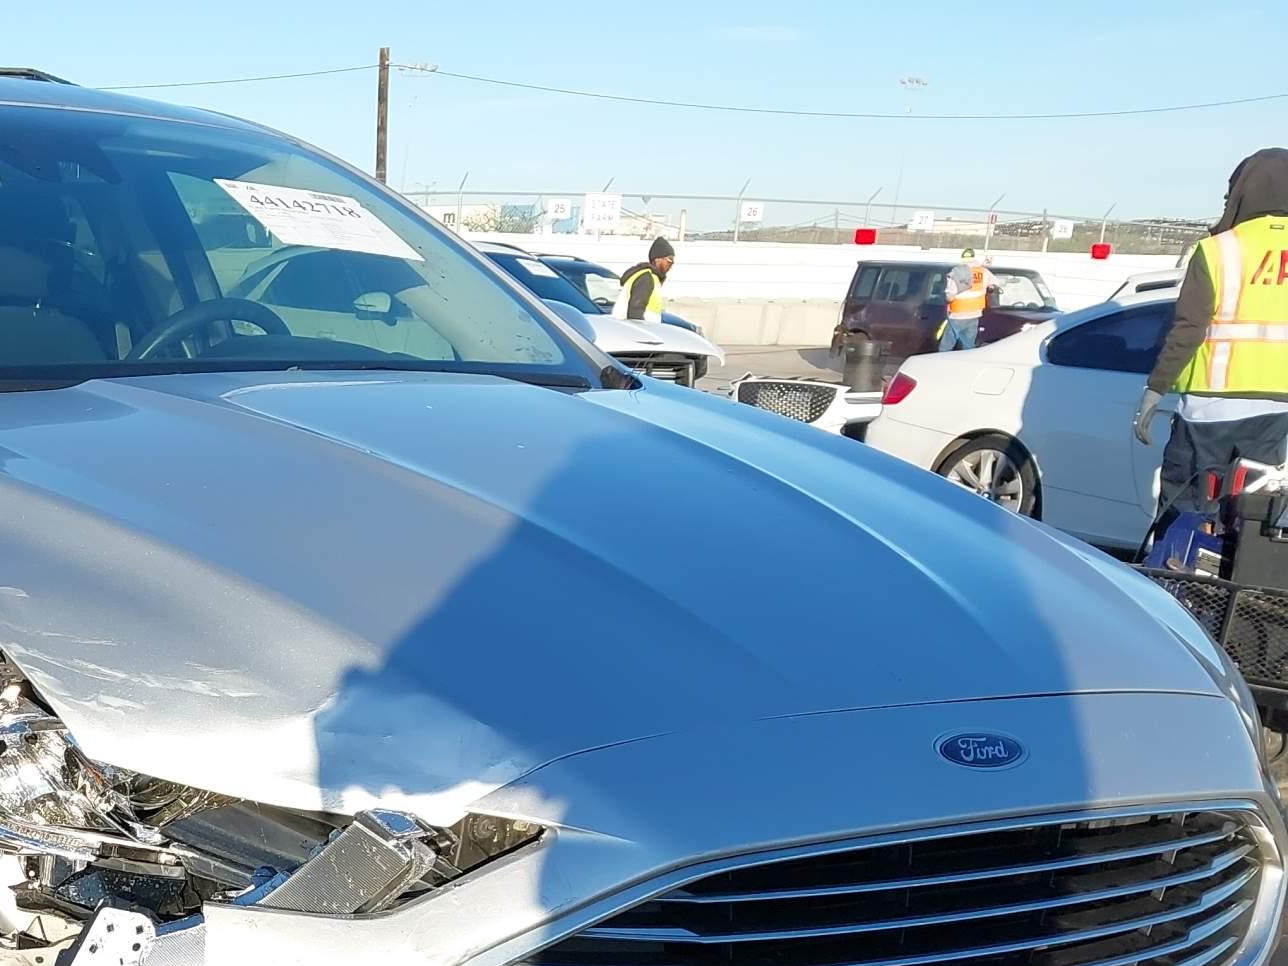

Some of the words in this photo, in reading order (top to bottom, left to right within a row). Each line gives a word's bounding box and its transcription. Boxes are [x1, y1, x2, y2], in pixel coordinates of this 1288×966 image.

[249, 194, 361, 218] 44142718
[554, 203, 566, 214] 25
[746, 207, 758, 217] 26
[957, 737, 1009, 762] Ford
